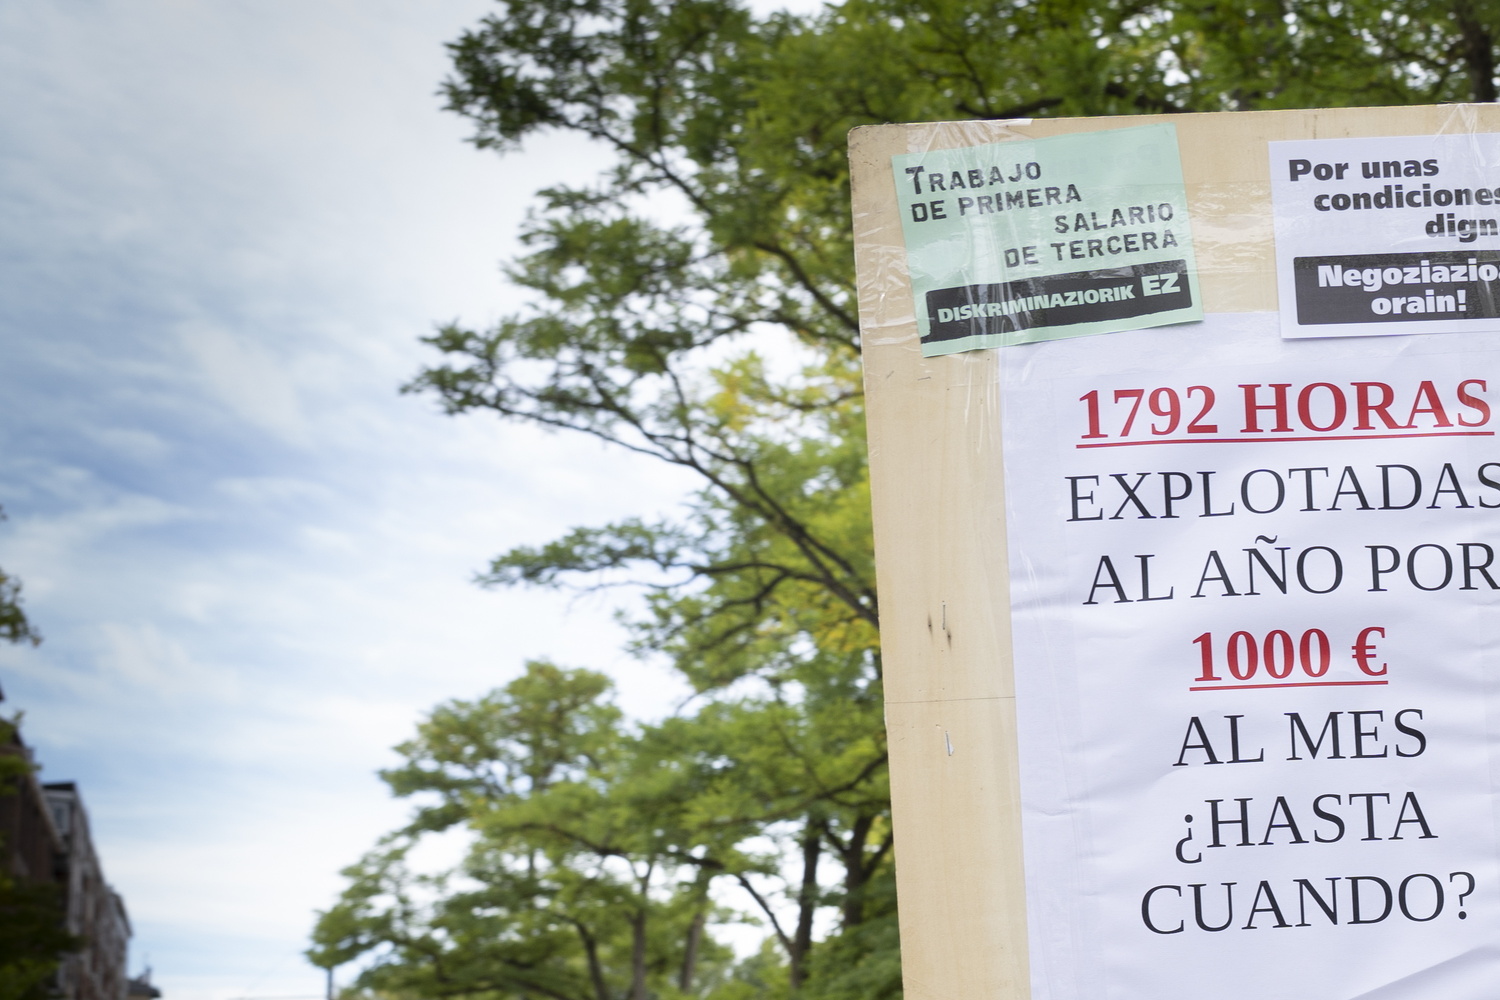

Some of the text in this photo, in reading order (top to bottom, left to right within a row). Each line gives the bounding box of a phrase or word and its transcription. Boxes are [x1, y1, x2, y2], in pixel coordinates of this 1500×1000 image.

[905, 161, 1042, 195] TRABAJO
[1288, 158, 1440, 182] Por unas
[911, 184, 1083, 223] DE PRIMERA
[1054, 203, 1174, 235] SALARIO
[1004, 229, 1179, 269] DE TERCERA
[937, 272, 1181, 324] DISKRIMINAZIORIK EZ
[1371, 289, 1467, 315] orain!
[1078, 378, 1492, 440] 1792 HORAS
[1082, 553, 1175, 606] AL
[1190, 534, 1344, 598] AÑO
[1192, 626, 1388, 683] 1000 €
[1172, 707, 1428, 767] AL MES
[1174, 790, 1439, 864] ¿HASTA
[1141, 870, 1476, 935] CUANDO?
